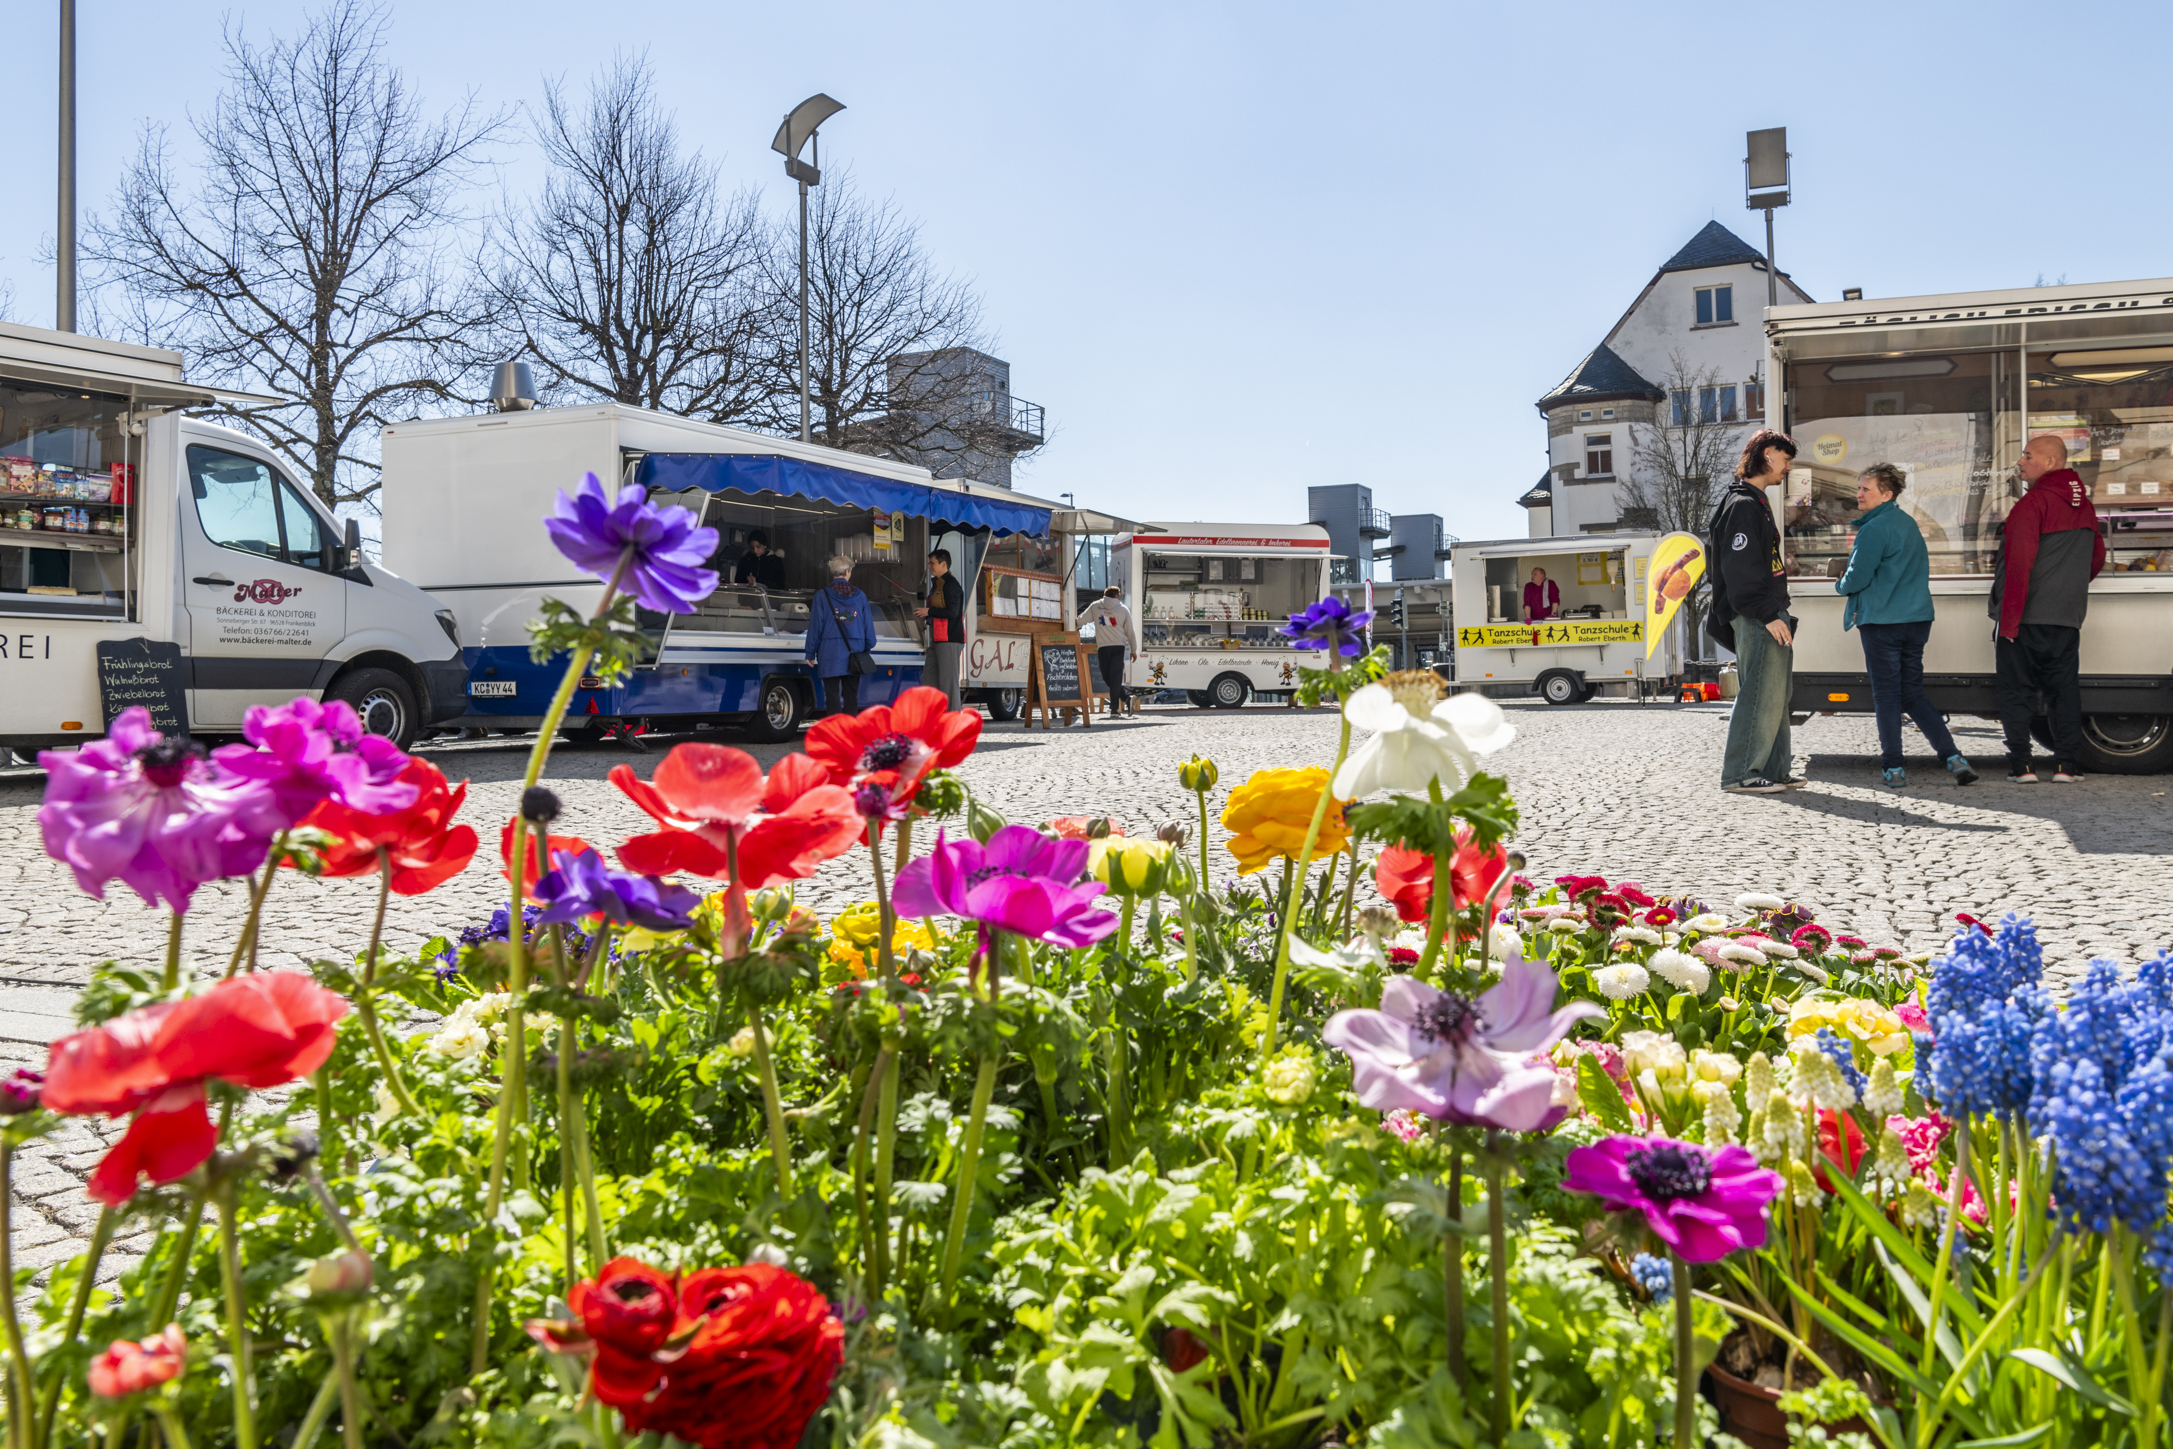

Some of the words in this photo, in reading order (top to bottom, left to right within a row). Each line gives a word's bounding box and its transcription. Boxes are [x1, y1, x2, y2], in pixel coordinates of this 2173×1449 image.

[1817, 441, 1842, 450] Heimat
[2068, 480, 2082, 507] EIPZIG
[1177, 537, 1213, 545] Lautertaler
[1268, 539, 1292, 547] Imkerei
[233, 583, 302, 602] Malter
[216, 606, 257, 616] BÄCKEREI
[259, 608, 265, 616] &
[267, 609, 317, 619] KONDITOREI
[216, 617, 250, 625] Sonneberger
[222, 626, 253, 635] Telefon:
[1487, 627, 1541, 637] Tanzschule
[1573, 624, 1630, 634] Tanzschule
[219, 636, 312, 646] www.bäckerei-malter.de
[1169, 658, 1189, 666] Liköre
[1197, 658, 1209, 666] Öle
[1218, 658, 1252, 666] Edelbrände
[1261, 659, 1279, 669] Honig
[474, 683, 486, 694] KC
[490, 683, 501, 694] YY
[502, 683, 513, 694] 44
[105, 688, 167, 701] Zwiebelbrot
